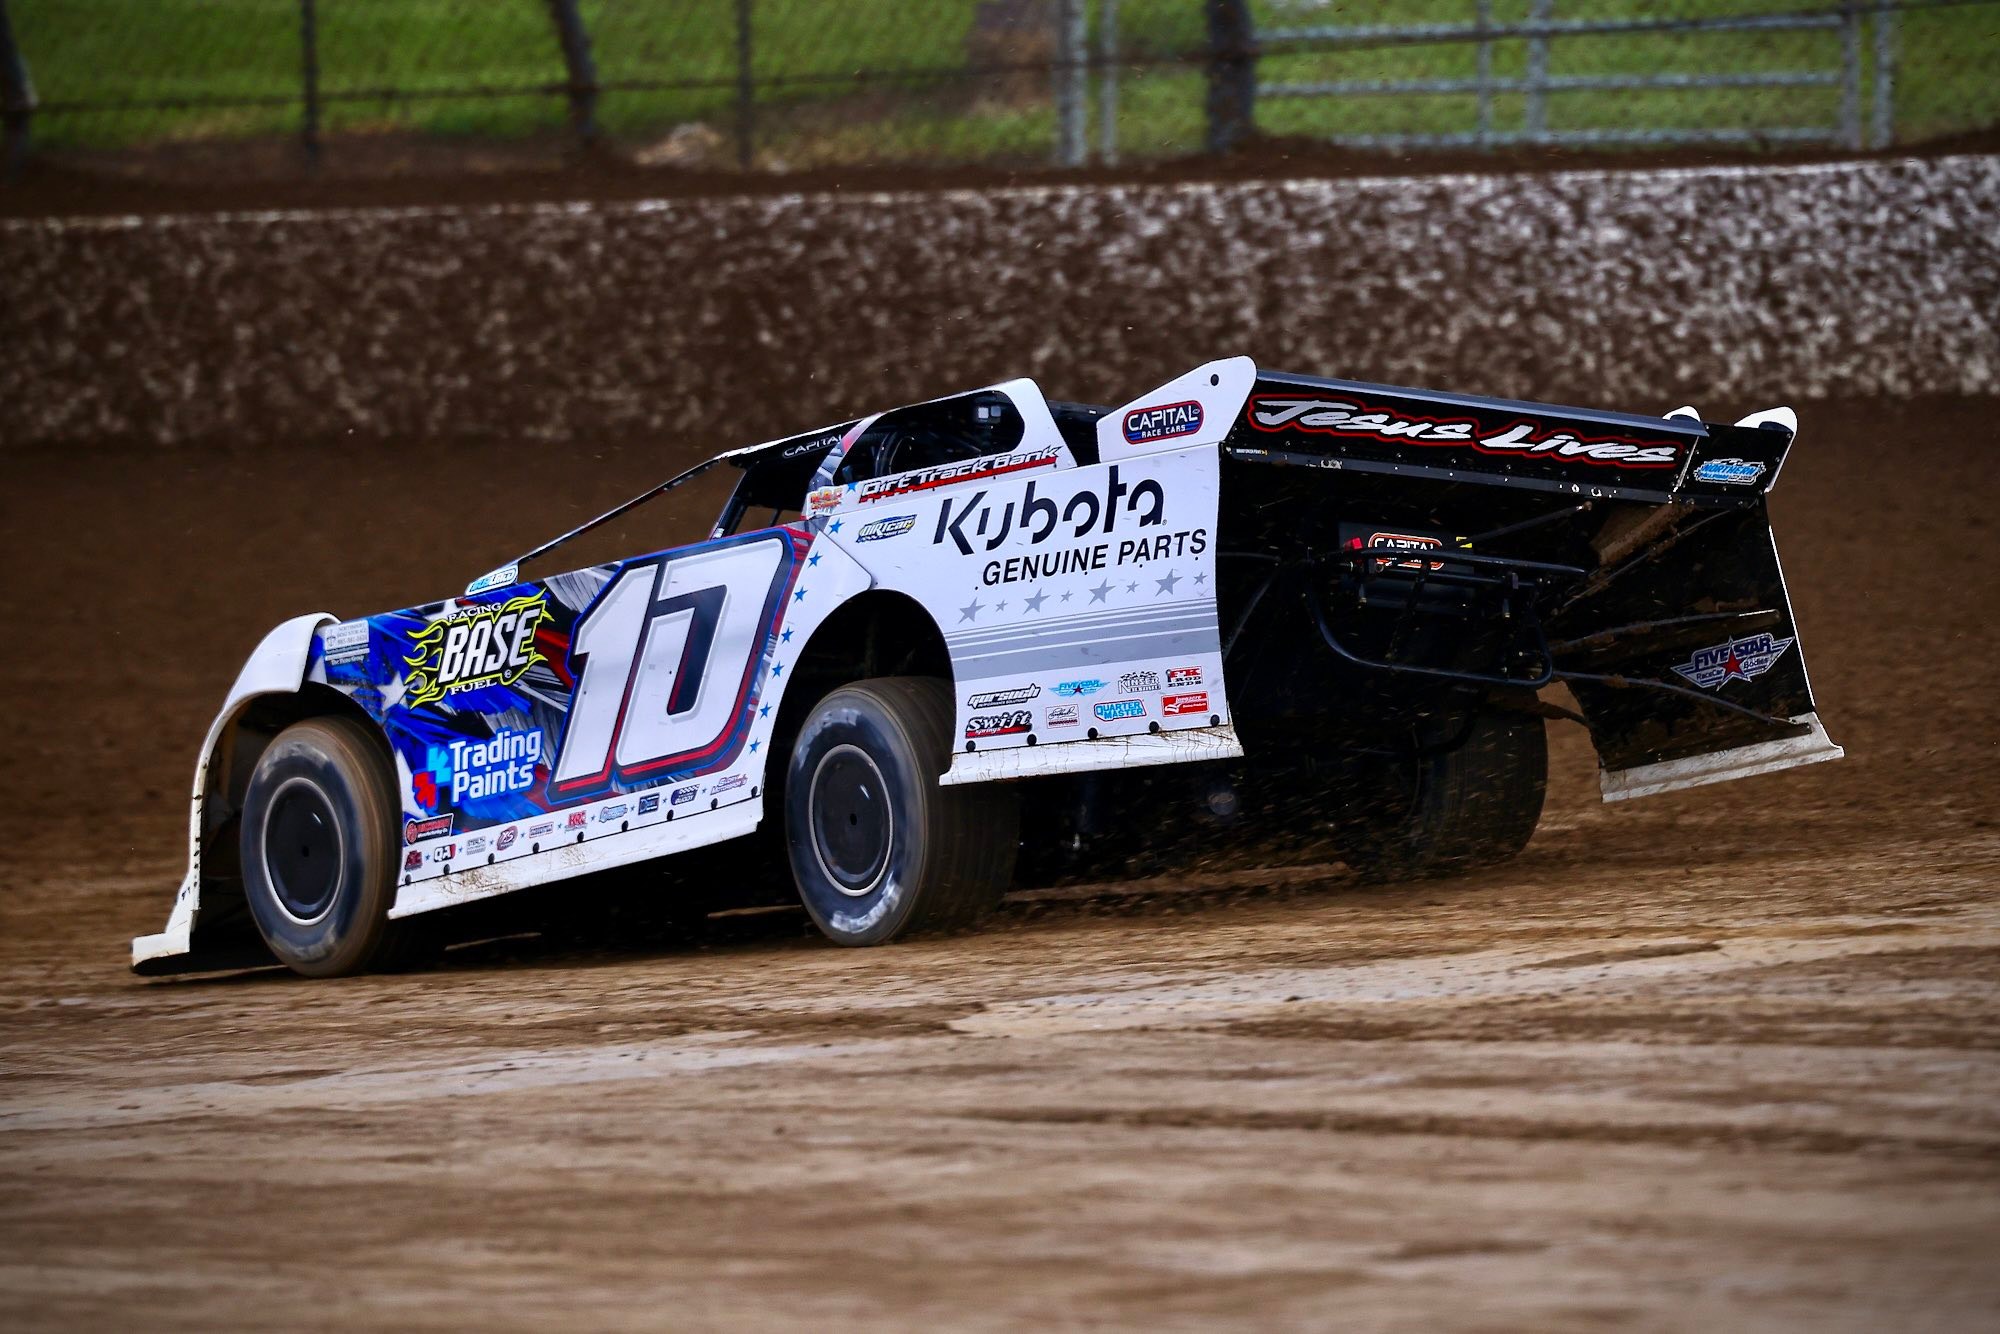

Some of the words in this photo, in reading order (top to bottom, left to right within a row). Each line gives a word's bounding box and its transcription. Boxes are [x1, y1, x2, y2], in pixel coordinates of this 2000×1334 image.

[1128, 405, 1199, 432] CAPITAL
[1142, 428, 1162, 438] RACE
[1166, 425, 1186, 434] CARS
[1256, 399, 1471, 438] Jesus
[1480, 424, 1677, 461] Lives
[862, 474, 910, 496] Dirt
[917, 459, 988, 484] Track
[993, 446, 1062, 469] Bank
[933, 465, 1164, 556] Kubota
[982, 544, 1108, 586] GENUINE
[1117, 529, 1207, 565] PARTS
[448, 602, 502, 623] RACING
[438, 608, 541, 683] BASE
[553, 537, 785, 784] 10
[1695, 647, 1728, 672] FIVE
[1734, 637, 1771, 657] STAR
[450, 678, 497, 696] FUEL
[1118, 676, 1160, 694] KINSER
[1096, 701, 1142, 716] QUARTER
[1104, 708, 1144, 719] MASTER
[449, 731, 542, 772] Trading
[453, 761, 534, 803] Paints
